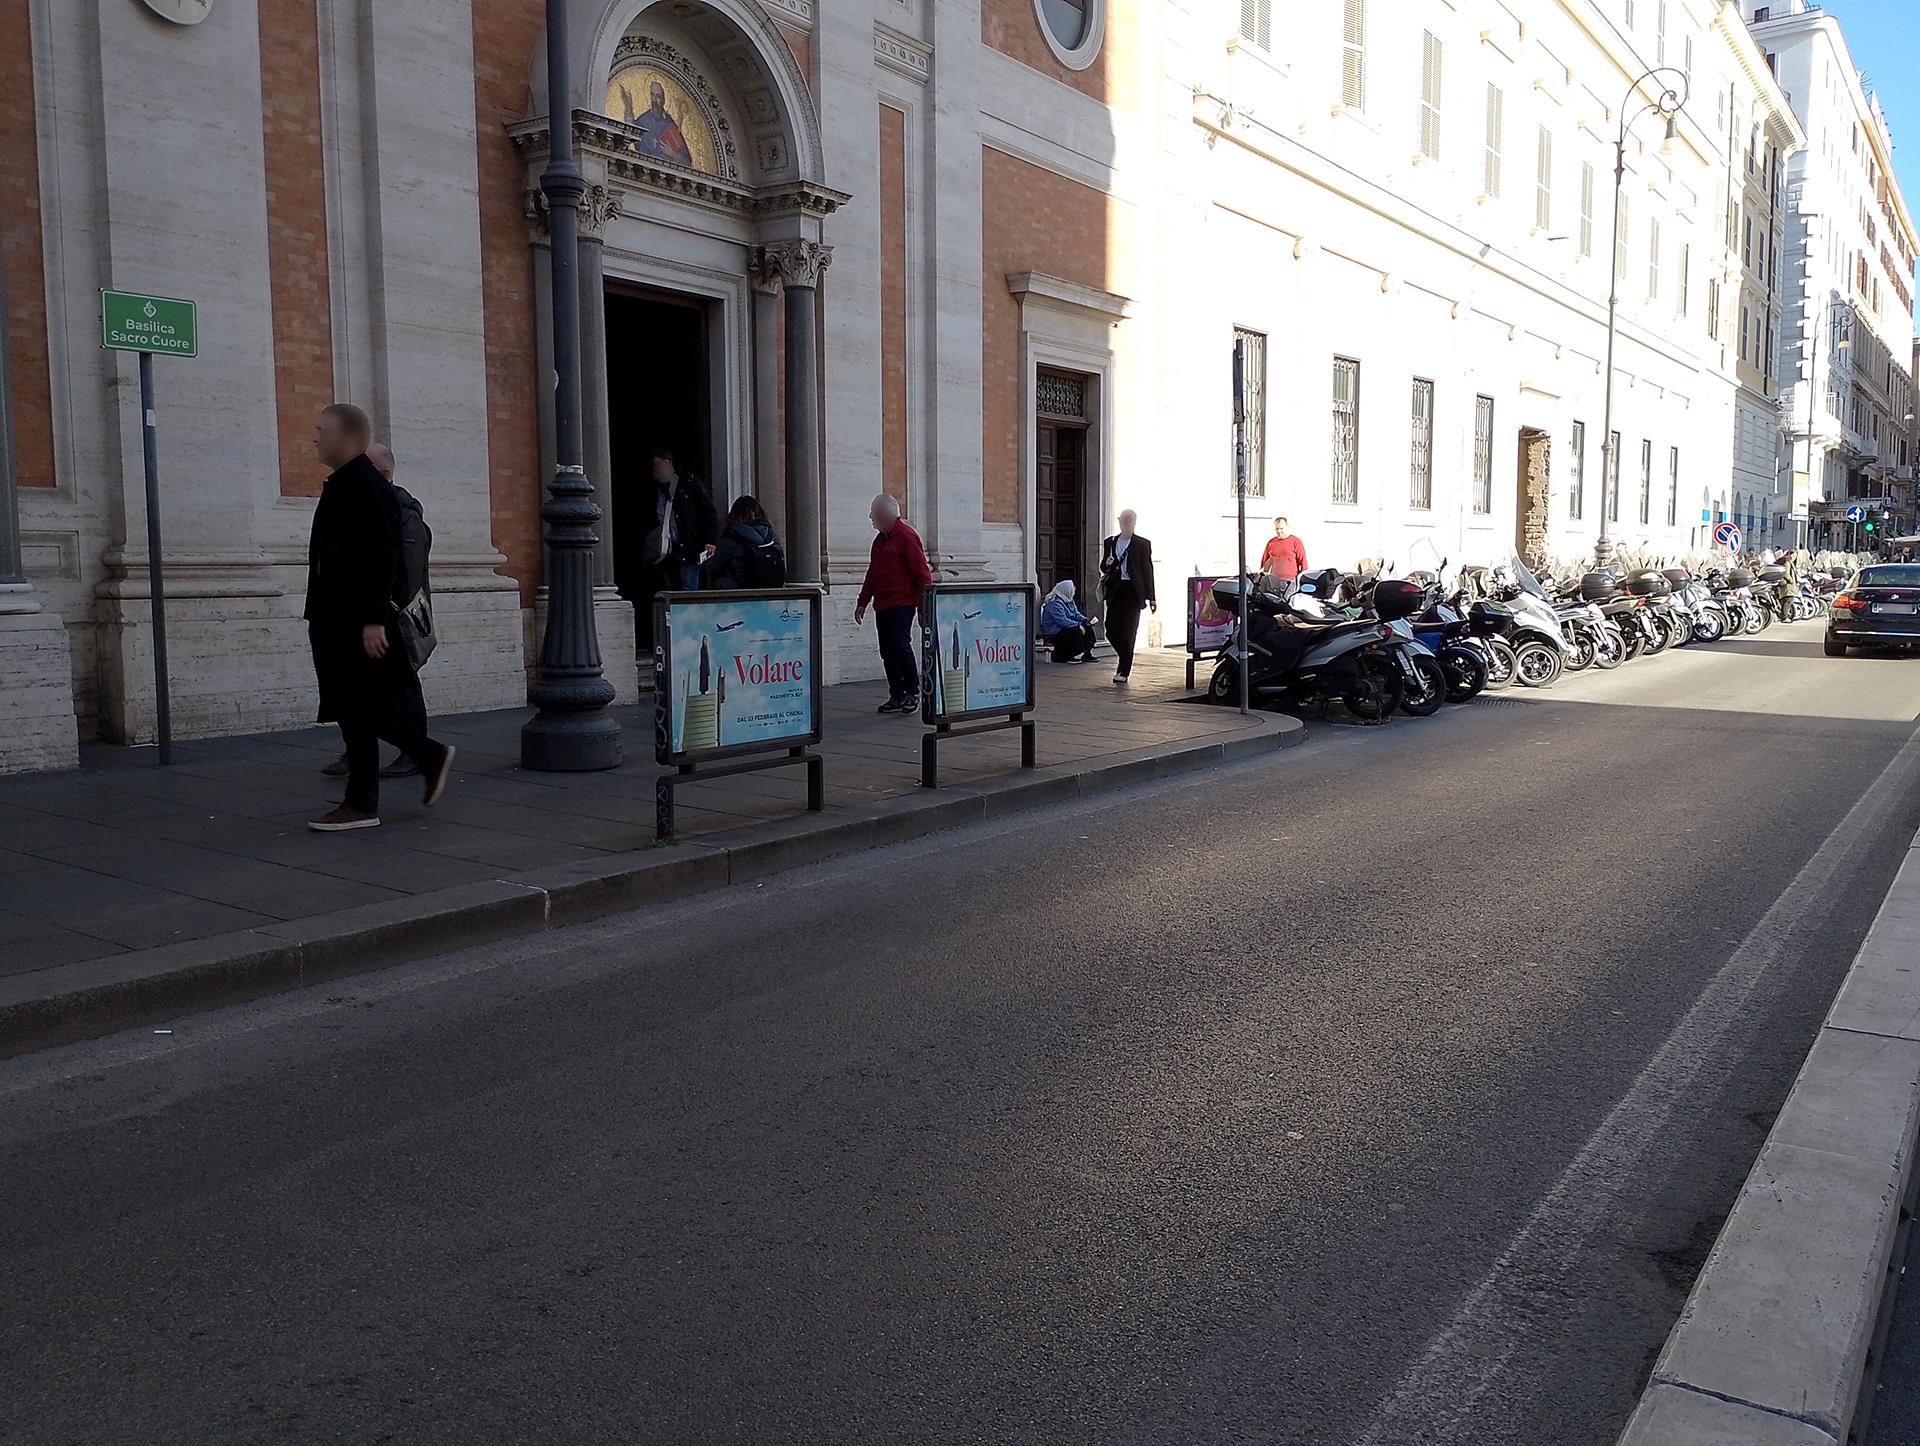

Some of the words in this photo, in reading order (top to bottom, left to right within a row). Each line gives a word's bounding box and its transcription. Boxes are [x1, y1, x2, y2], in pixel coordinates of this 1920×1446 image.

[125, 319, 175, 335] Basilica
[111, 330, 148, 344] Sacro
[151, 335, 190, 349] Cuore
[976, 638, 1021, 665] Volare
[732, 654, 803, 686] Volare
